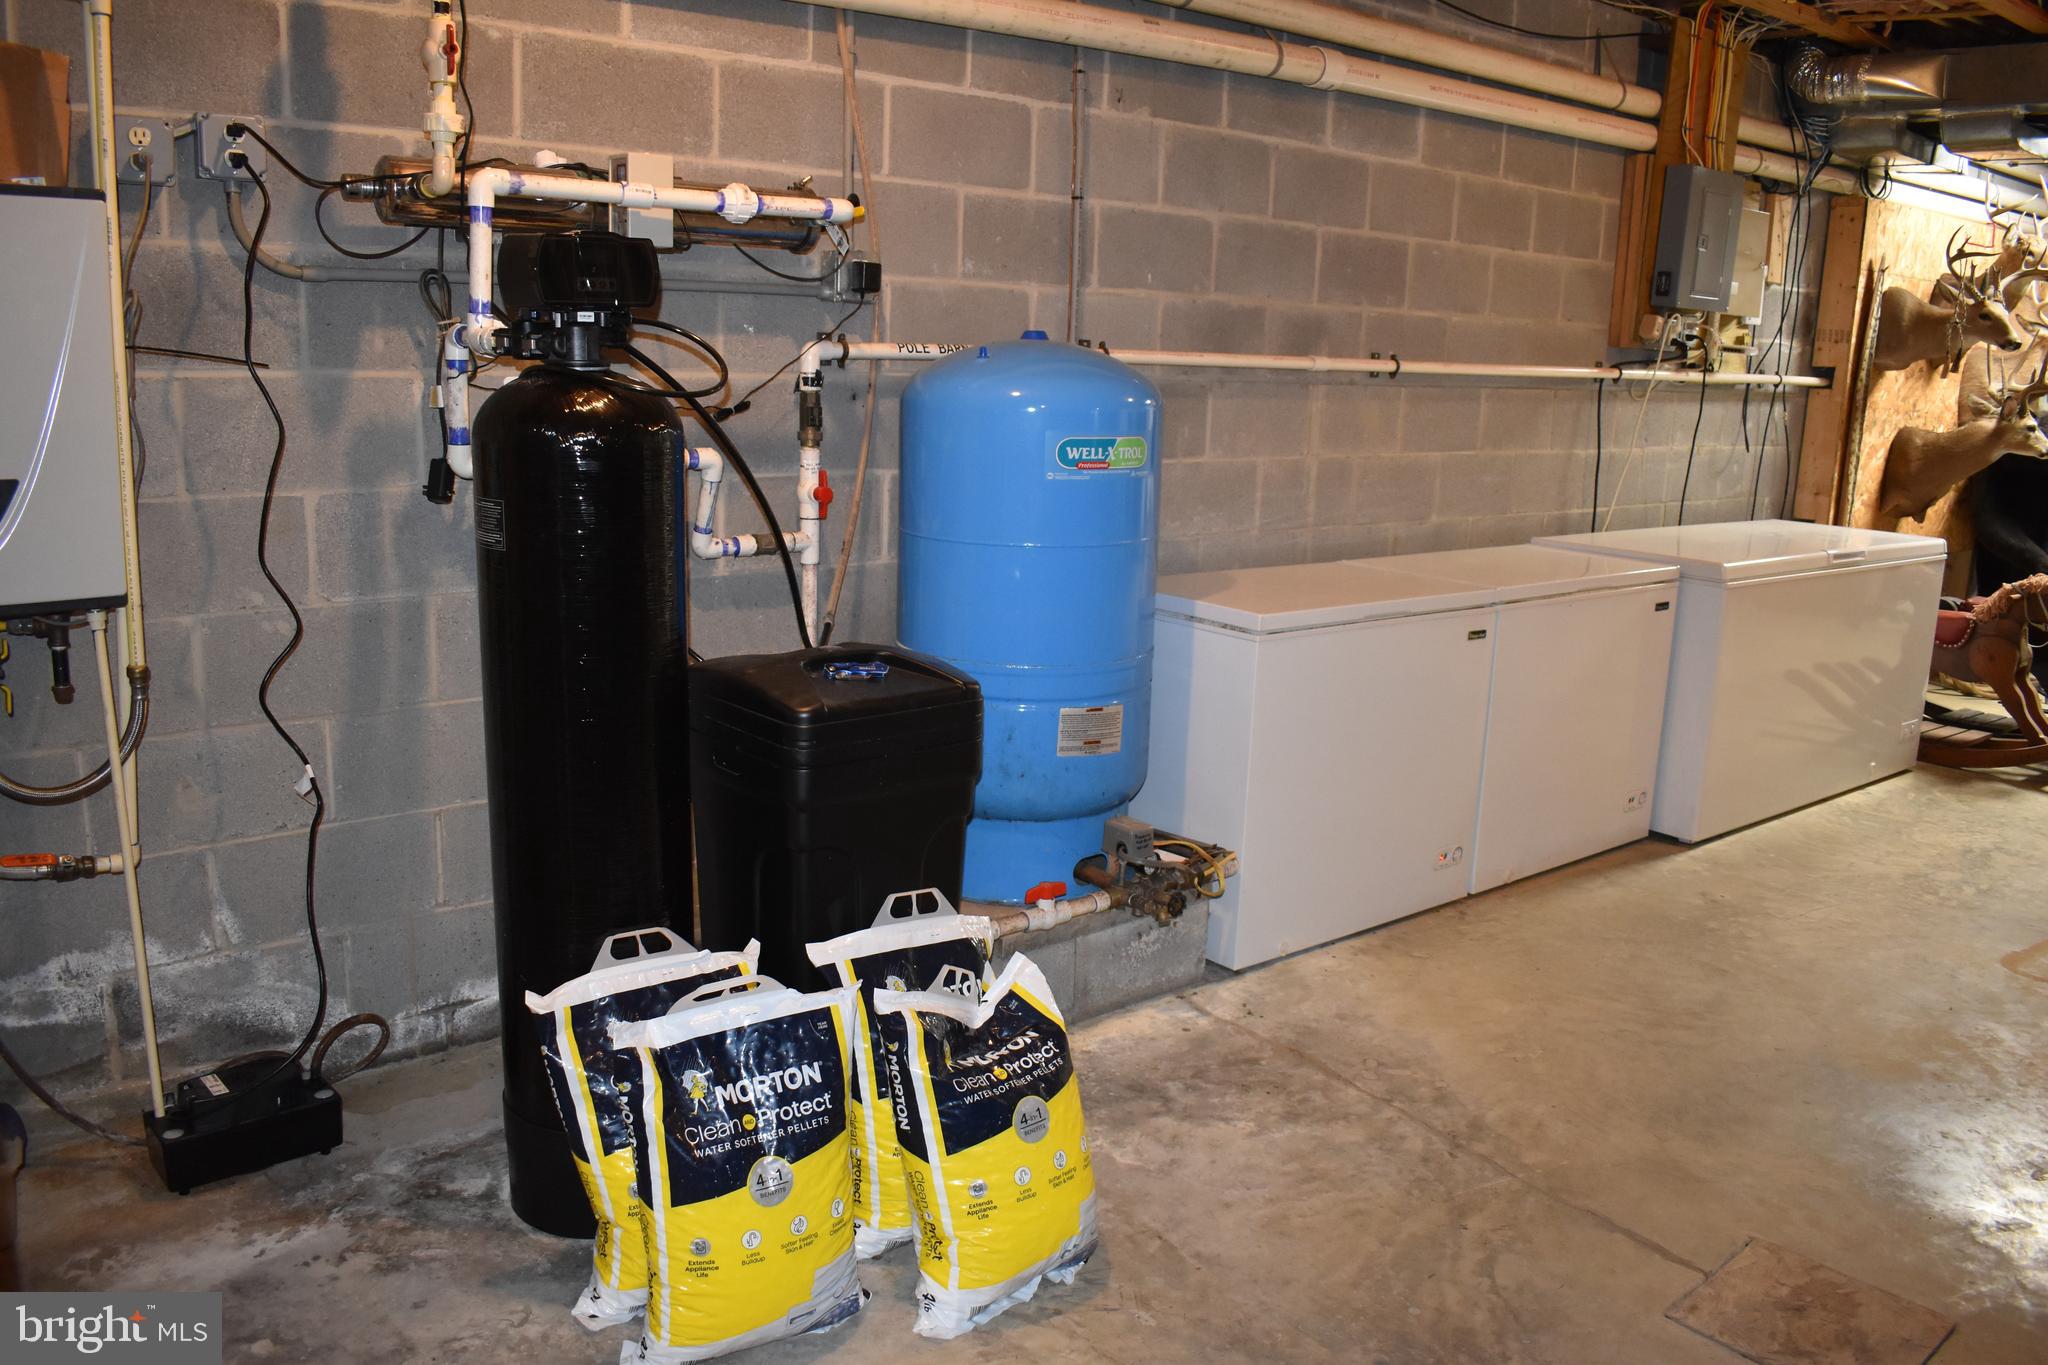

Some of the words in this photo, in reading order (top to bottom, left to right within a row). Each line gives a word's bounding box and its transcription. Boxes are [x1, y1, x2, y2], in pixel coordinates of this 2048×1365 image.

[896, 342, 931, 354] POLE
[953, 1072, 997, 1092] Clean
[1005, 1040, 1060, 1075] Protect
[714, 1061, 822, 1110] MORTON
[963, 1089, 994, 1105] WATER
[994, 1075, 1033, 1096] SOFTENER
[1033, 1057, 1064, 1078] PELLETS
[888, 1054, 911, 1131] MORTON
[684, 1114, 742, 1145] Clean
[758, 1093, 832, 1127] Protect
[694, 1138, 732, 1158] WATER
[734, 1127, 785, 1149] SOFTENER
[787, 1115, 830, 1135] PELLETS
[854, 1159, 863, 1205] Protect
[914, 1170, 929, 1209] Clean
[1019, 1187, 1032, 1195] Less
[1016, 1192, 1037, 1203] Buildup
[966, 1204, 998, 1217] Appliance
[968, 1199, 994, 1210] Extends
[780, 1239, 798, 1250] Softer
[798, 1231, 819, 1243] Feeling
[746, 1251, 760, 1259] Less
[785, 1244, 798, 1254] Skin
[741, 1256, 766, 1266] Buildup
[685, 1265, 720, 1273] Appliance
[696, 1271, 708, 1279] Life
